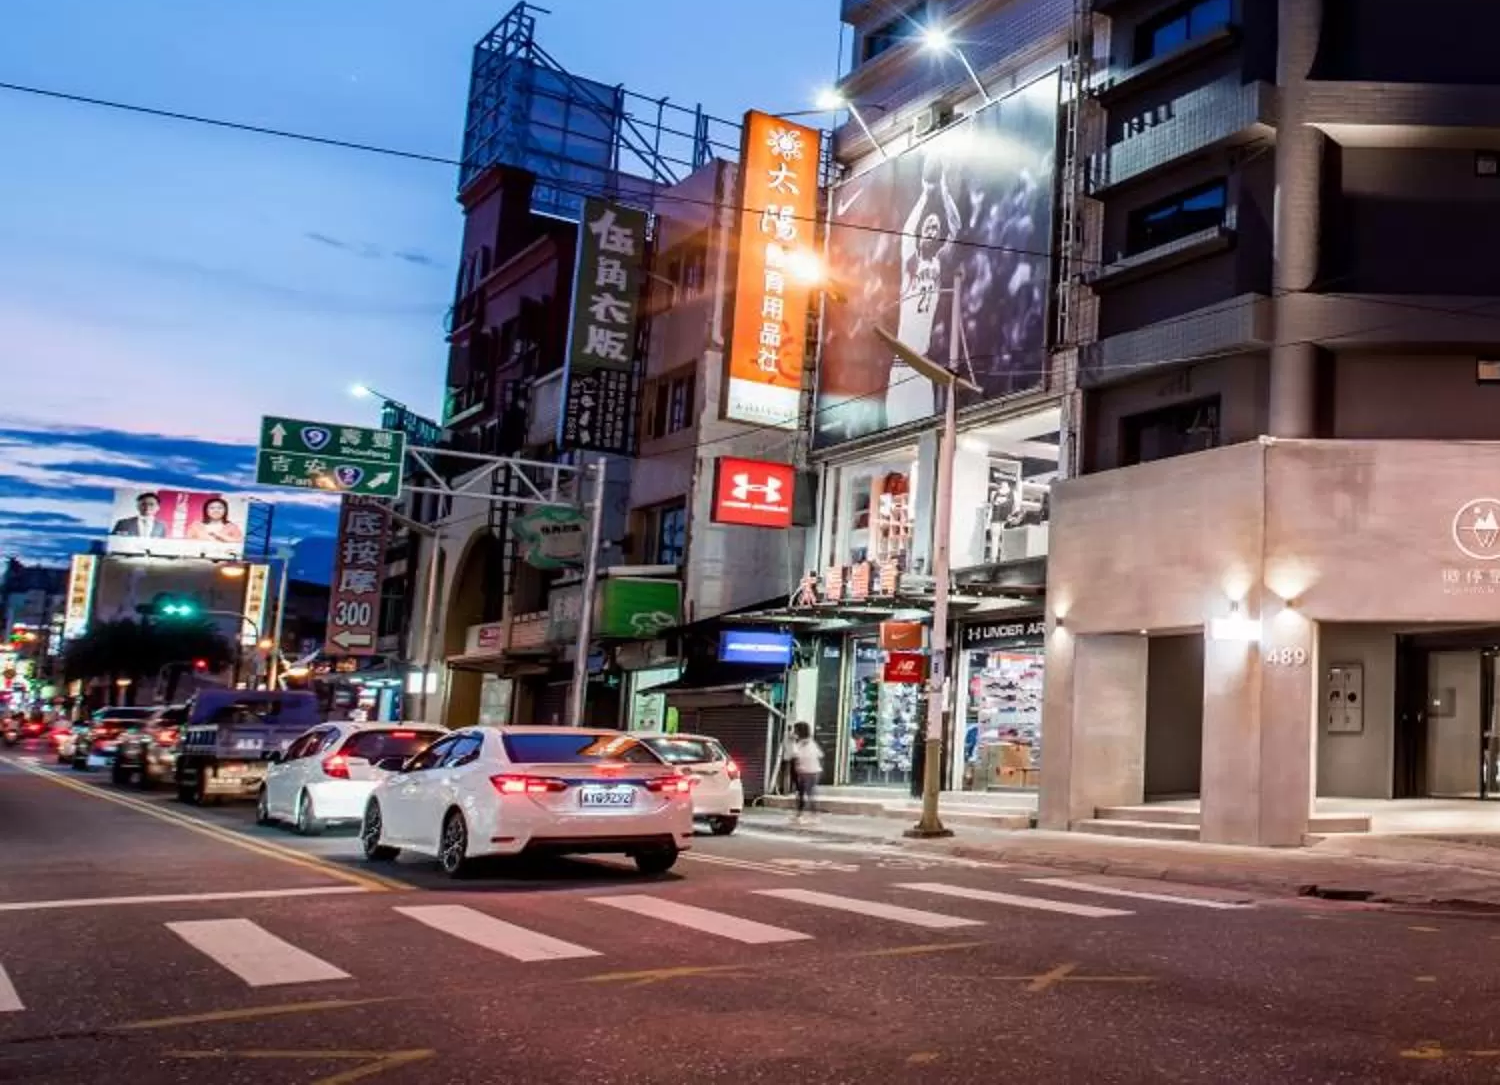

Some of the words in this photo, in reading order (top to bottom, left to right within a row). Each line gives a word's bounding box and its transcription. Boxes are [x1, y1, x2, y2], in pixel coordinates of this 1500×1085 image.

[270, 455, 327, 475] 吉安
[335, 602, 371, 626] 300
[983, 623, 1025, 638] UNDER
[1266, 647, 1308, 664] 489
